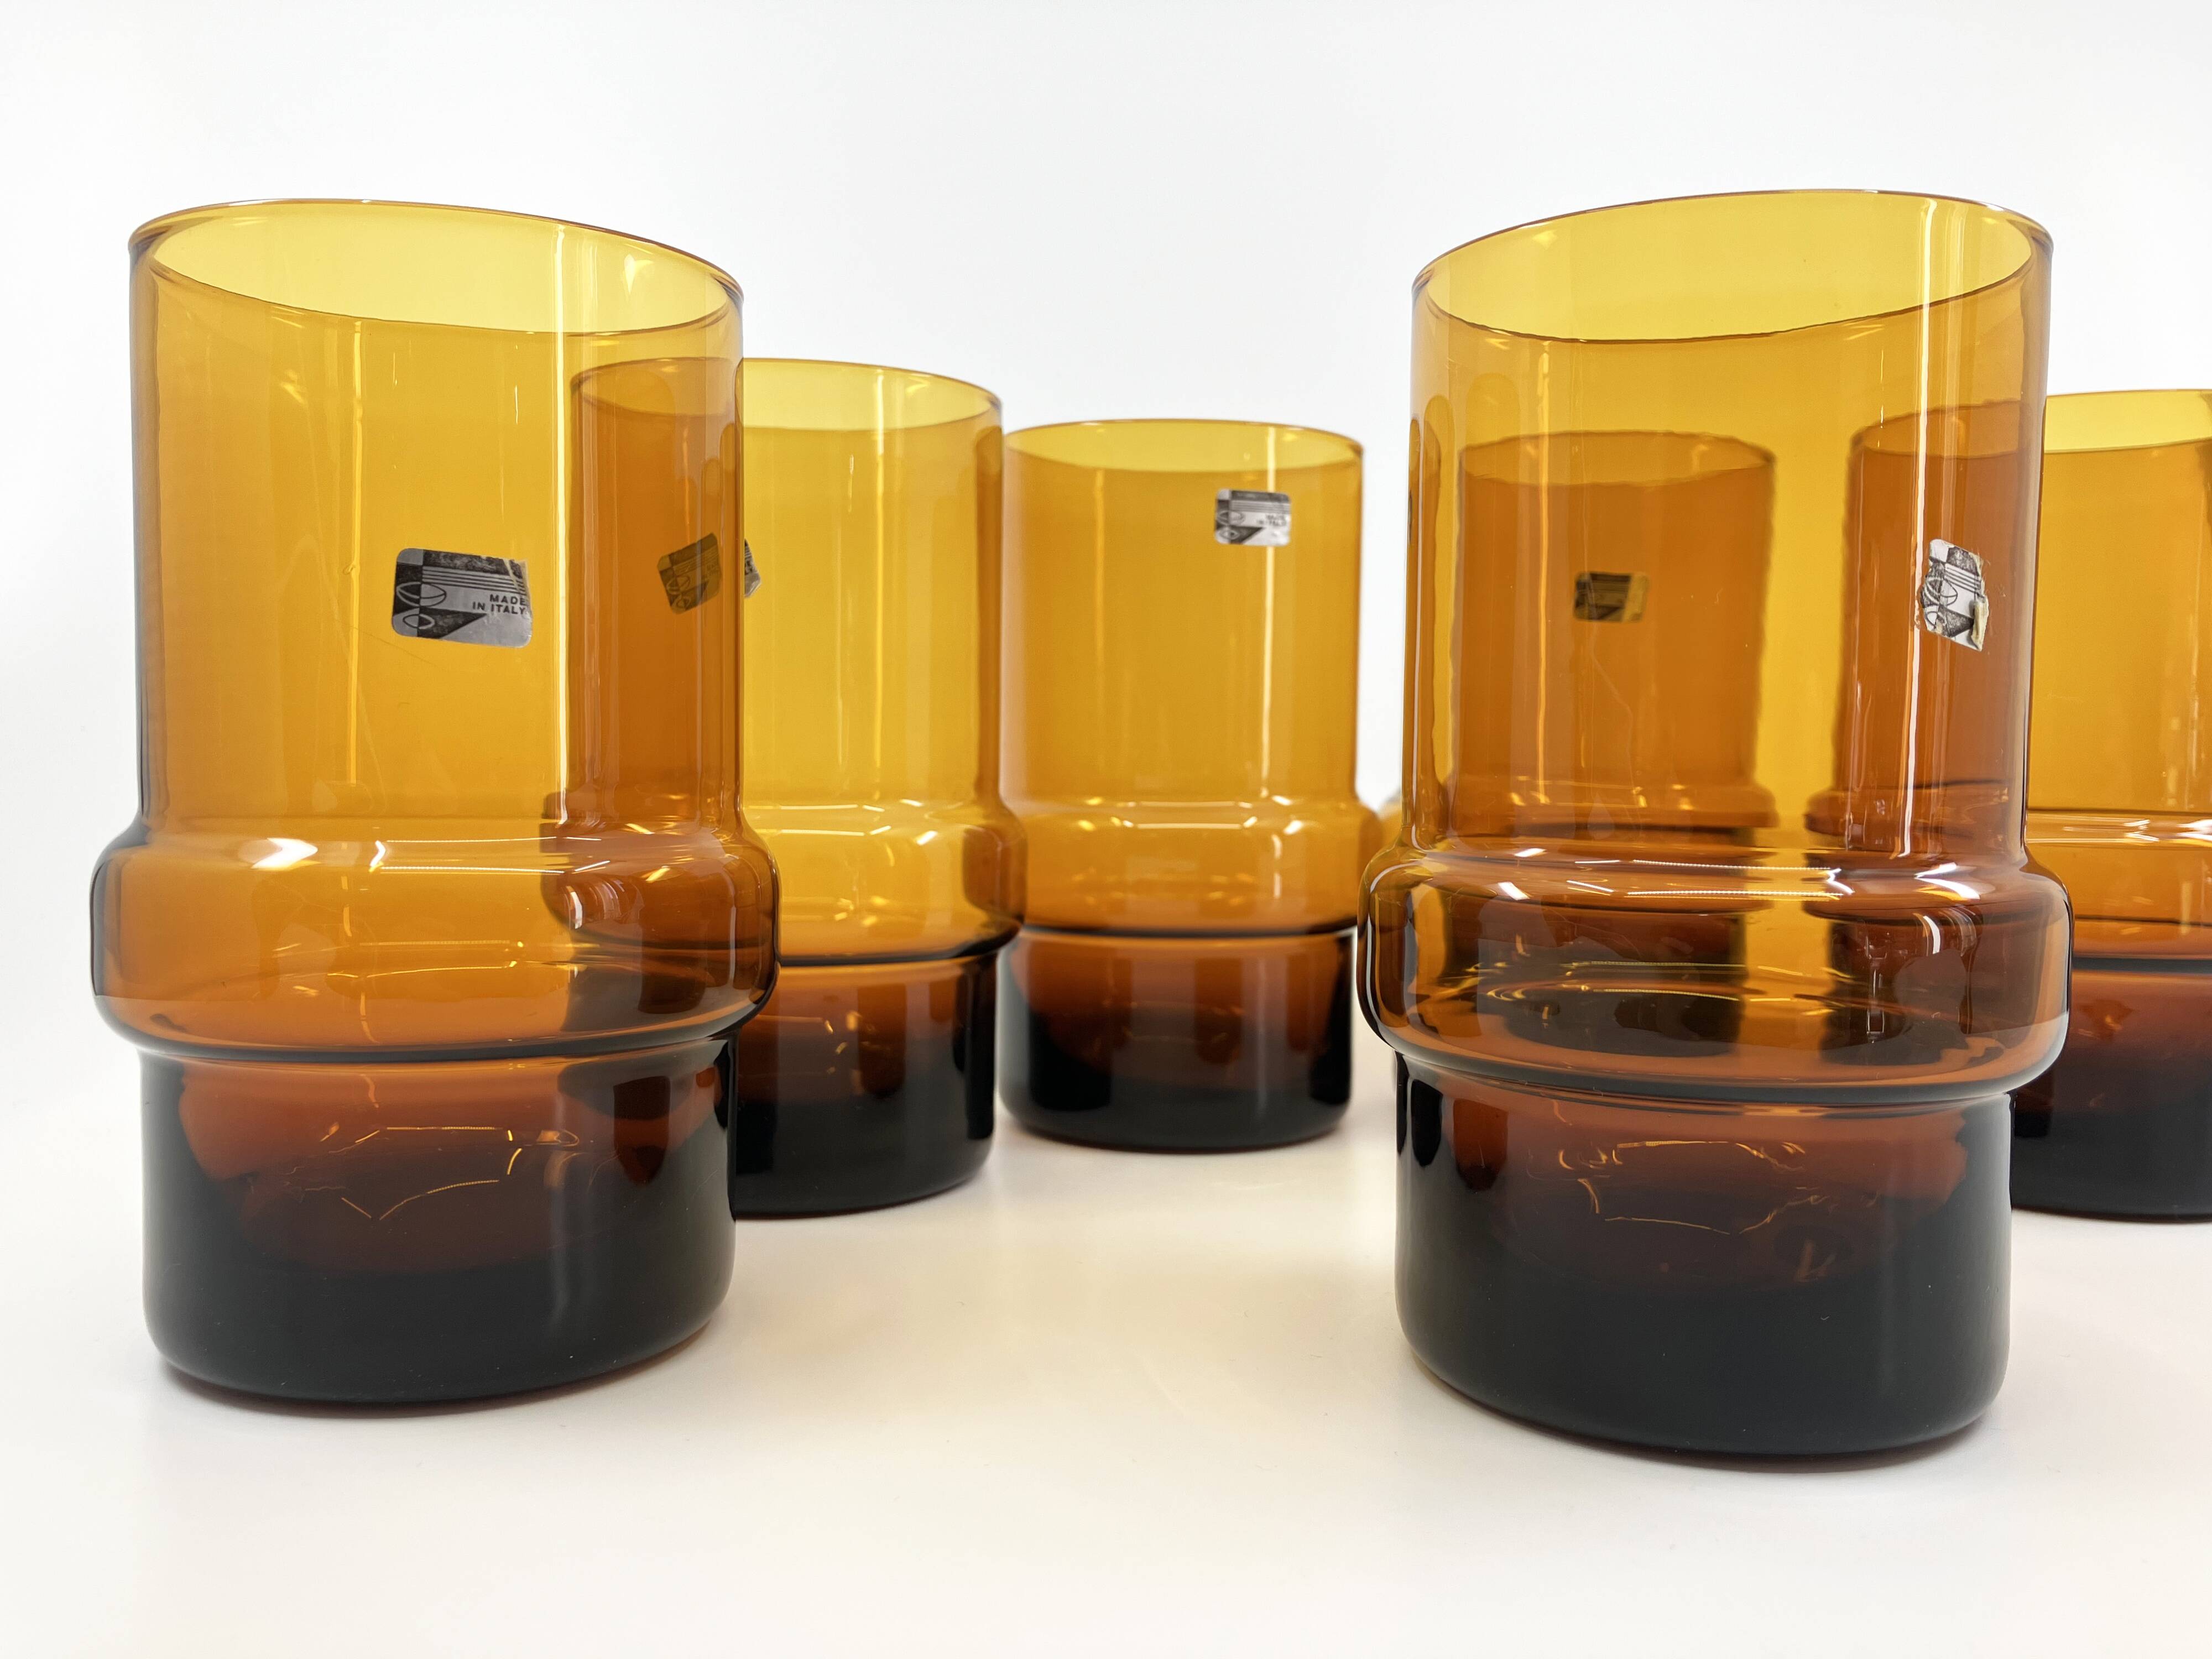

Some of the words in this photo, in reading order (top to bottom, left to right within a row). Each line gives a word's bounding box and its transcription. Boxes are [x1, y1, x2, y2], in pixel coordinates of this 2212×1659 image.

[489, 594, 526, 606] MADE
[473, 602, 485, 610] IN
[491, 604, 525, 614] ITALY
